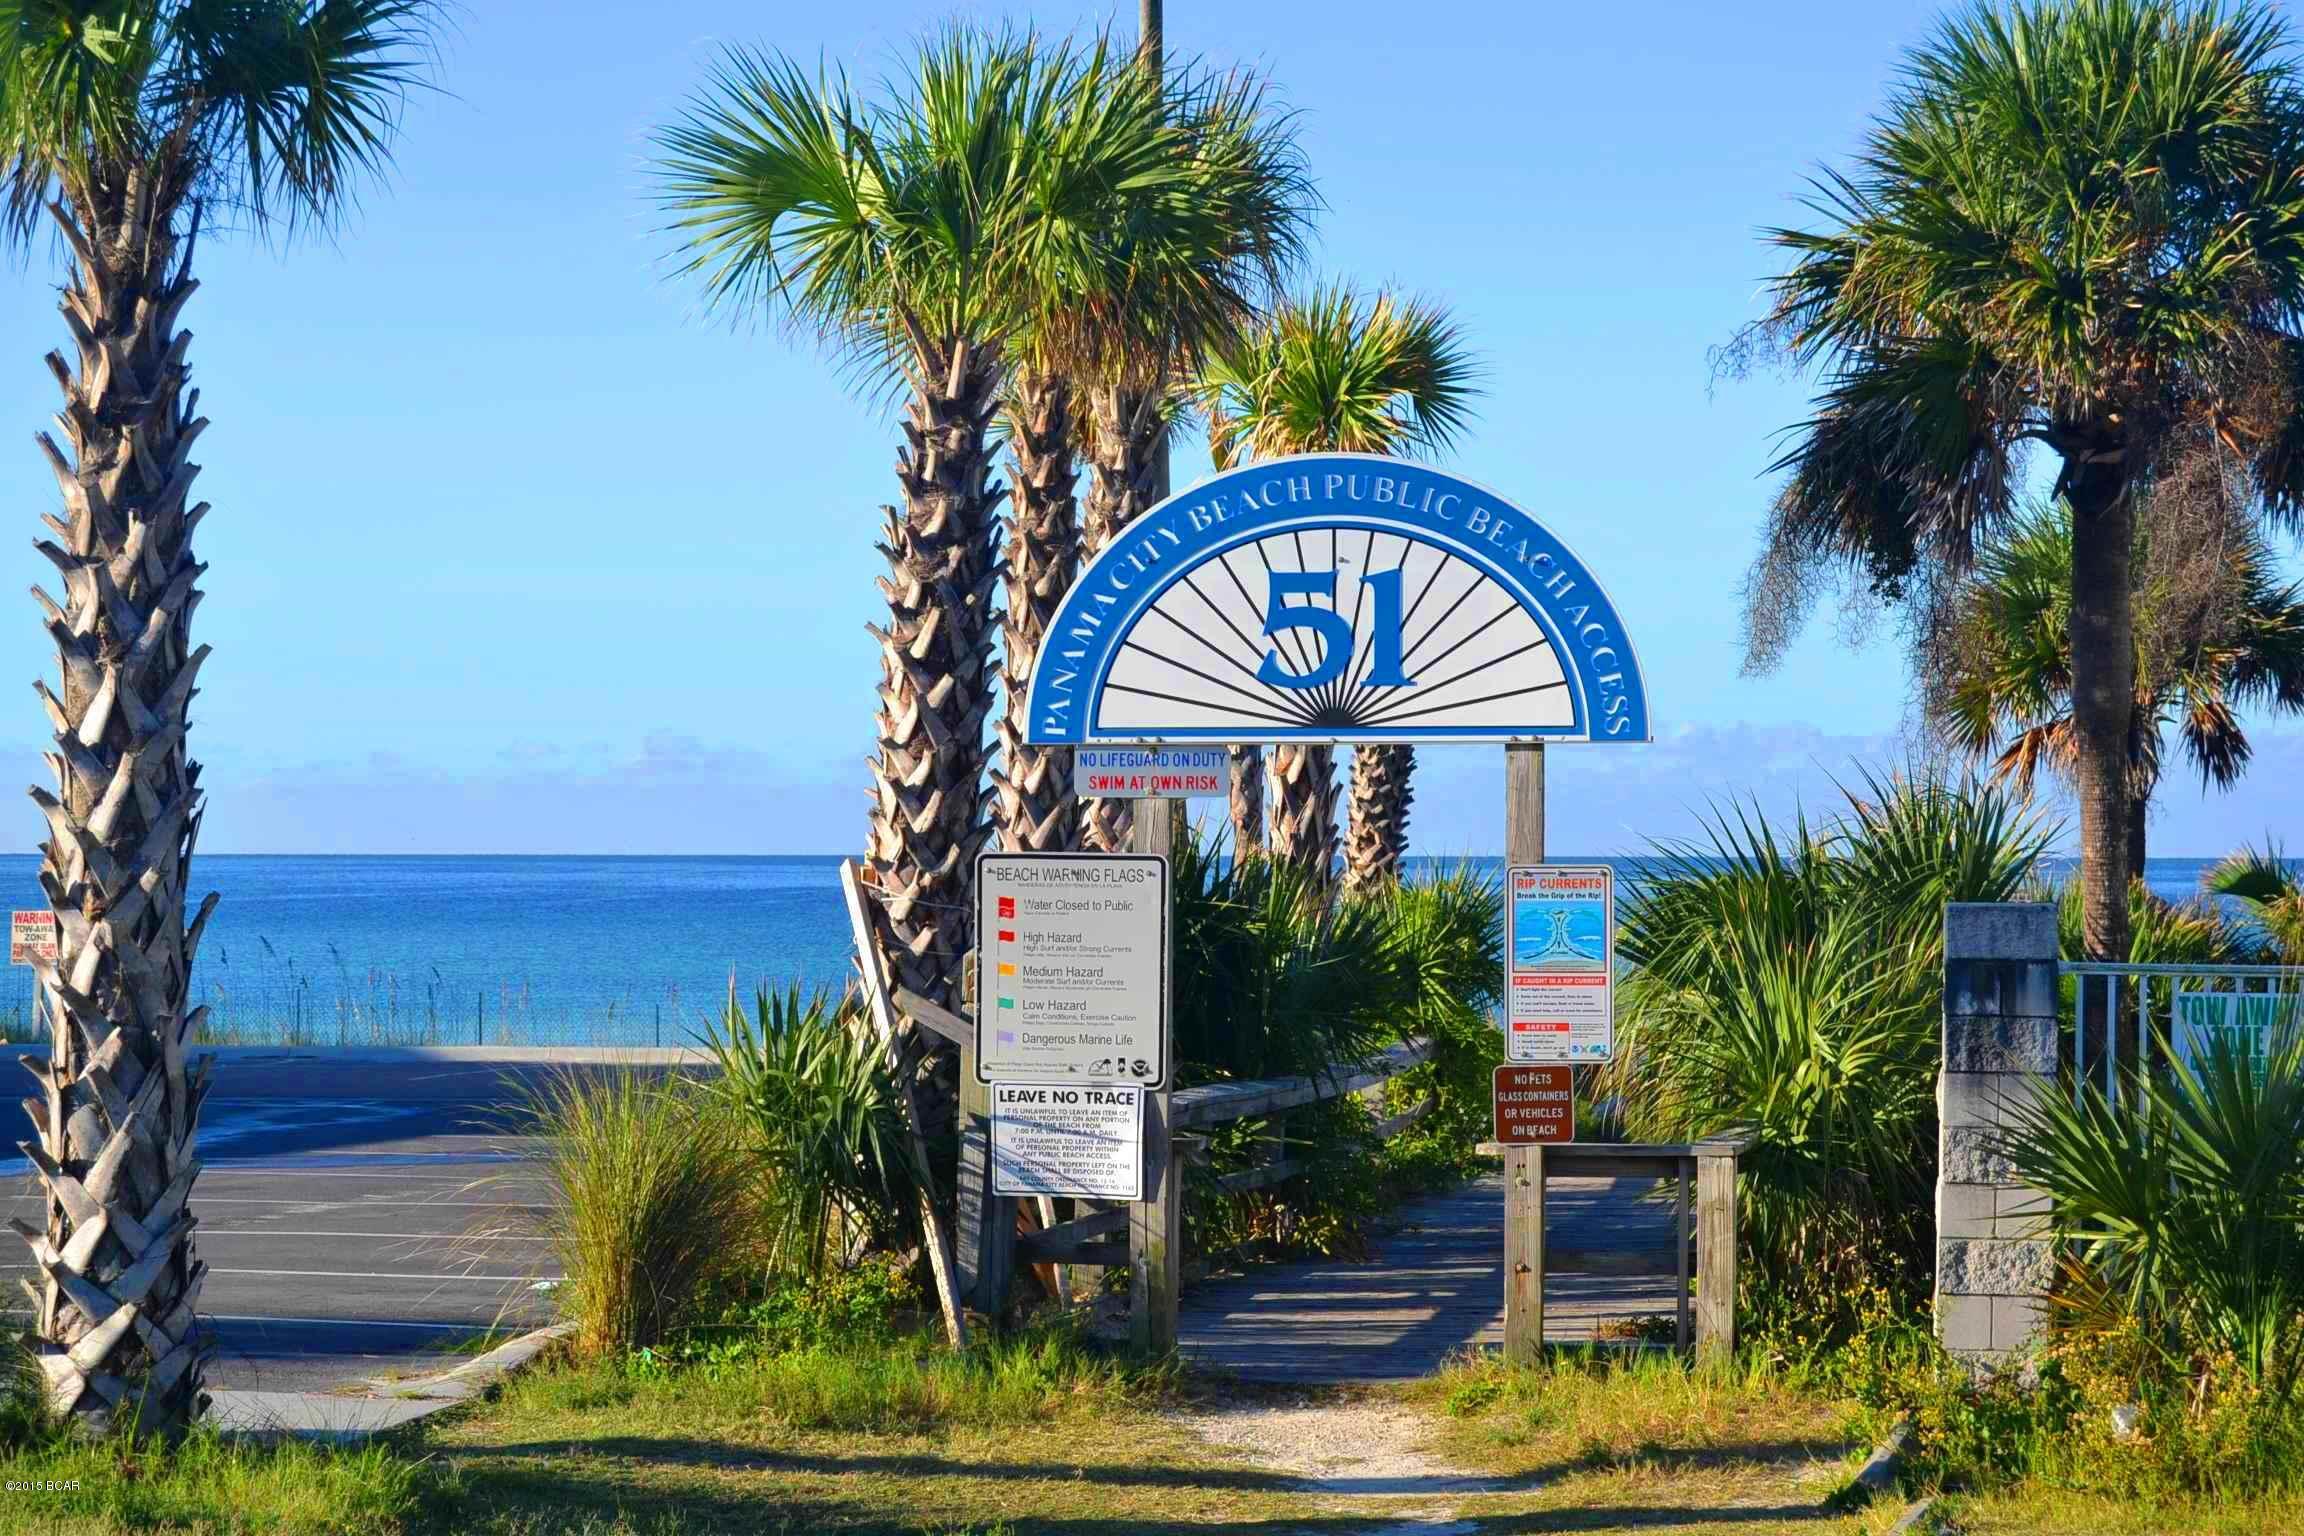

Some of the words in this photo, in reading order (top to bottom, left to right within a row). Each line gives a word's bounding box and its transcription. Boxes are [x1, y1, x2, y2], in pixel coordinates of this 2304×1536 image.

[1042, 592, 1118, 736] PANAMA
[1109, 519, 1185, 590] CITY
[1187, 475, 1312, 532] BEACH
[1324, 474, 1462, 521] PUBLIC
[1464, 506, 1576, 600] BEACH
[1563, 604, 1631, 735] ACCESS
[1255, 568, 1418, 689] 51
[1079, 752, 1097, 767] NO
[1100, 752, 1169, 768] LIFEGUARD
[1173, 752, 1190, 767] ON
[1193, 752, 1226, 767] DUTY
[1088, 776, 1125, 790] SWIM
[1130, 776, 1146, 790] AT
[1150, 776, 1182, 790] OWN
[1186, 776, 1218, 790] RISK
[996, 867, 1038, 881] BEACH
[1042, 868, 1100, 882] WARNING
[1104, 869, 1145, 883] FLAGS
[1517, 878, 1536, 888] RIP
[1539, 878, 1602, 888] CURRENTS
[1551, 892, 1565, 900] Grip
[1588, 892, 1601, 900] Rip!
[1024, 899, 1053, 911] Water
[1055, 899, 1089, 911] Closed
[1092, 900, 1102, 911] to
[1104, 899, 1134, 911] Public
[15, 912, 52, 924] WARNIN
[15, 925, 54, 933] TOW-AWA
[1023, 932, 1044, 946] High
[1048, 932, 1082, 943] Hazard
[1023, 944, 1038, 952] High
[1040, 944, 1055, 952] Surf
[1079, 945, 1102, 953] Strong
[1103, 945, 1132, 953] Currents
[1022, 965, 1063, 977] Medium
[1066, 967, 1104, 977] Hazard
[1022, 999, 1045, 1010] Low
[1048, 1000, 1087, 1011] Hazard
[2178, 996, 2228, 1025] TOW
[1022, 1032, 1076, 1046] Dangerous
[1079, 1034, 1112, 1045] Marine
[1115, 1034, 1134, 1045] Life
[1514, 1074, 1527, 1084] NO
[1529, 1073, 1552, 1085] PETS
[999, 1090, 1047, 1103] LEAVE
[1052, 1091, 1079, 1104] NO
[1084, 1091, 1134, 1105] TRACE
[1498, 1092, 1522, 1102] GLASS
[1523, 1091, 1569, 1101] CONTAINERS
[1504, 1108, 1517, 1119] OR
[1519, 1108, 1563, 1118] VEHICLES
[1512, 1125, 1525, 1135] ON
[1526, 1124, 1557, 1135] BEACH
